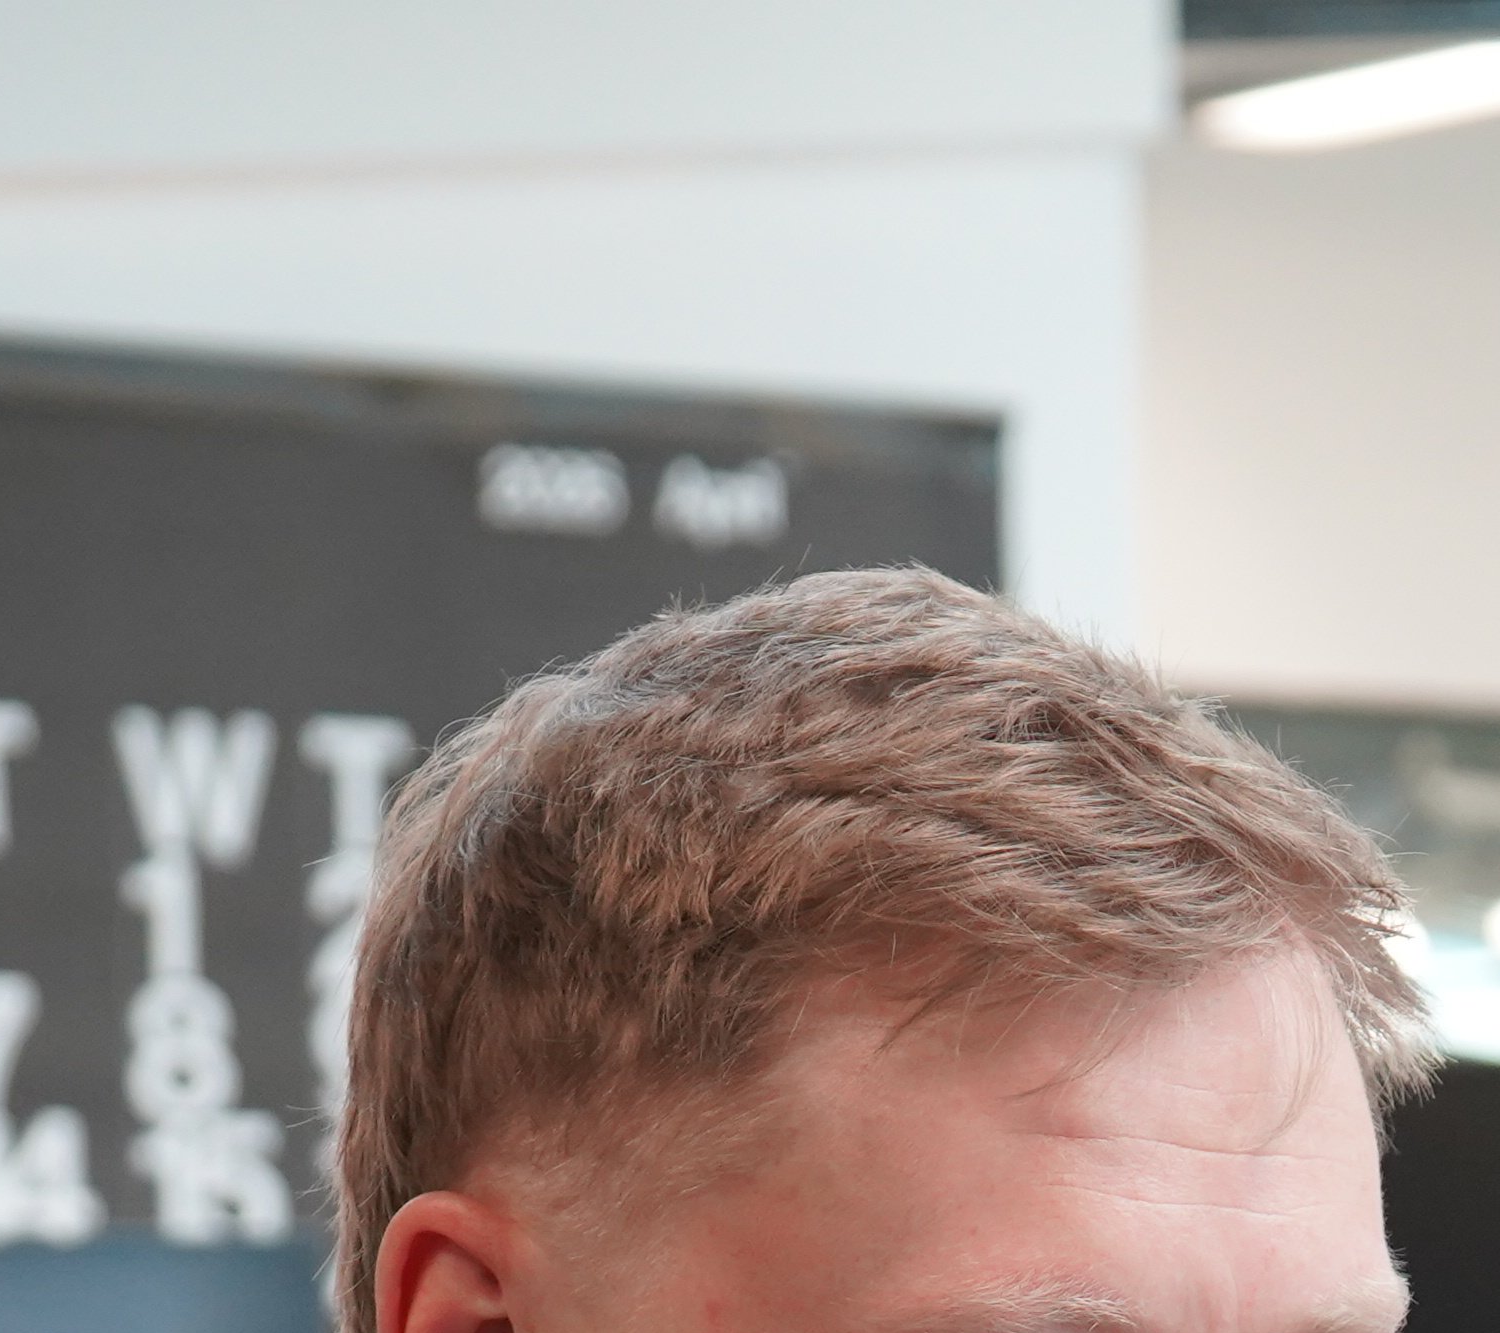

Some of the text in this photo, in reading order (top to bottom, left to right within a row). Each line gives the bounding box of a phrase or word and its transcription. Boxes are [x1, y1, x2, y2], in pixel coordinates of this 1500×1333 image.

[113, 706, 276, 868] W
[301, 716, 412, 845] T
[122, 842, 202, 978] 1
[126, 974, 240, 1124] 8
[128, 1110, 291, 1246] 15
